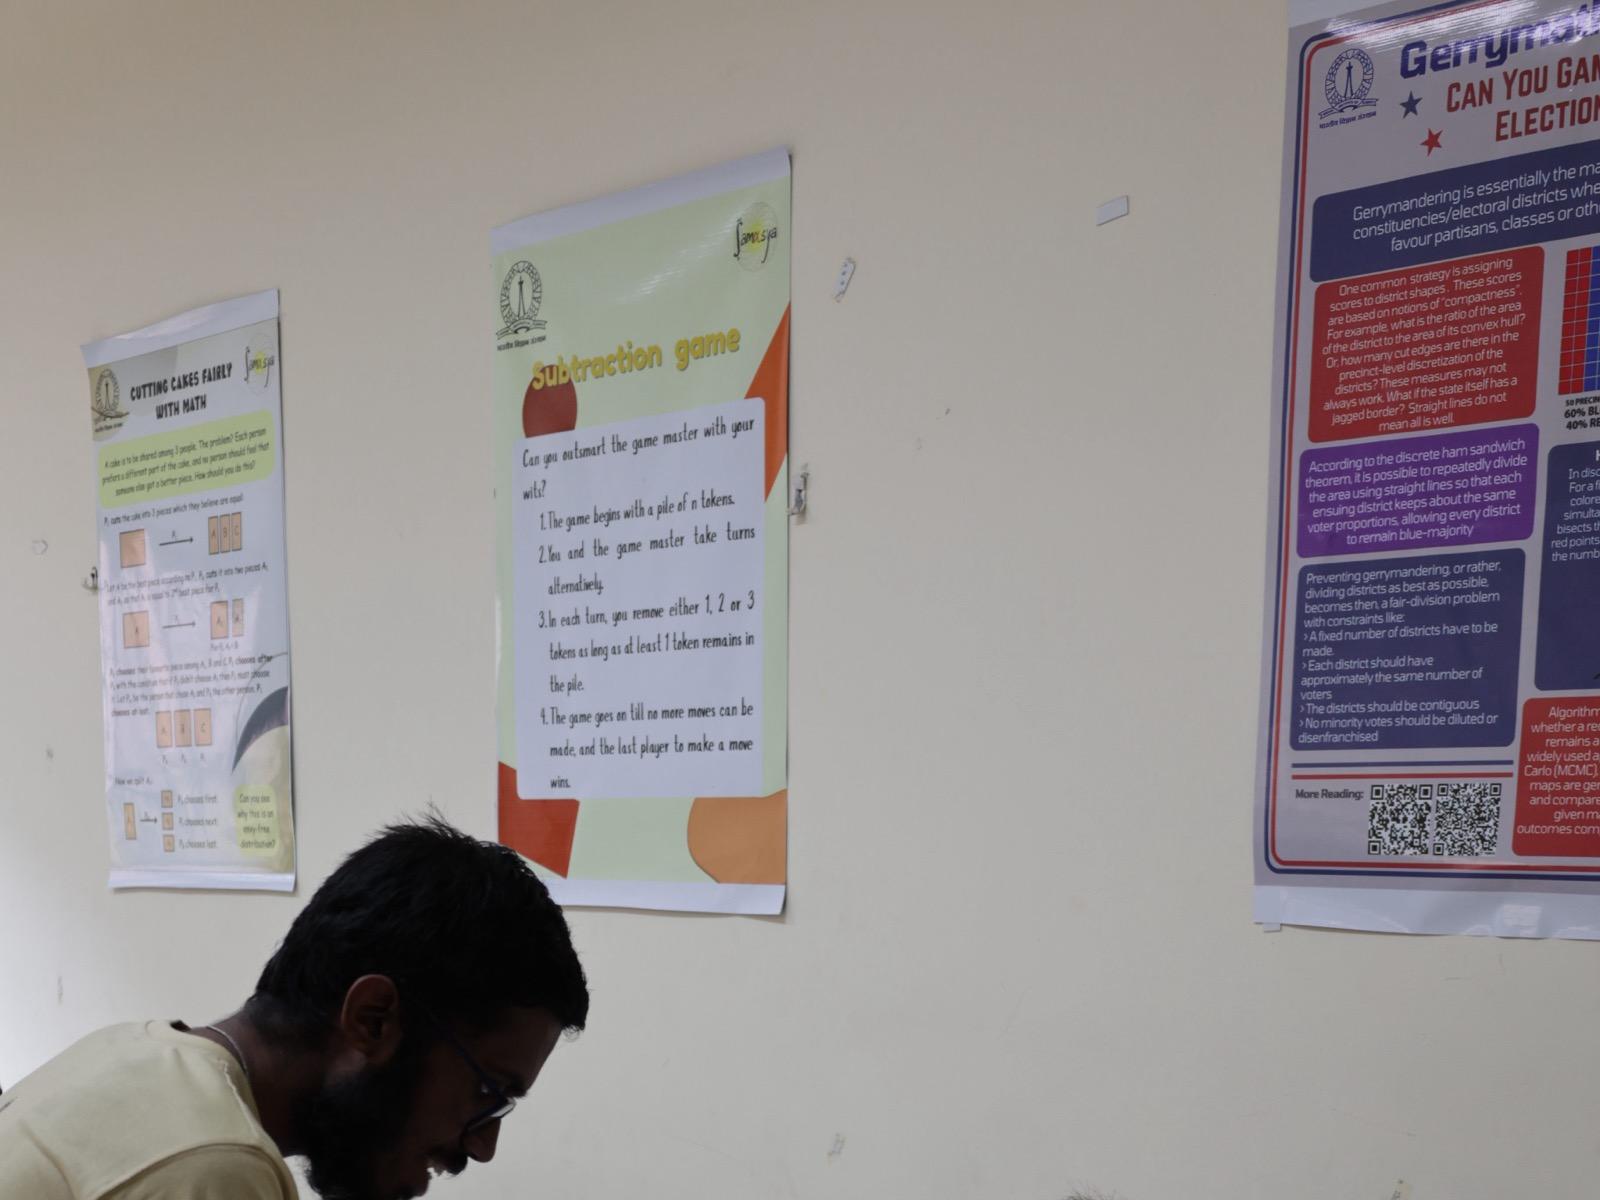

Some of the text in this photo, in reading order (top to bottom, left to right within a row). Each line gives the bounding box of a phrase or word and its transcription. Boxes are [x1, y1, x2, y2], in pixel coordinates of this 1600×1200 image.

[1446, 78, 1494, 112] CAN
[1503, 66, 1548, 100] YOU
[1352, 189, 1460, 220] Gerrymandering
[1476, 169, 1550, 196] essentially
[1552, 166, 1576, 181] the
[1352, 195, 1509, 239] constituencies/electoral
[1511, 188, 1567, 208] districts
[1391, 233, 1432, 251] favour
[1434, 221, 1498, 246] partisans,
[1501, 210, 1554, 230] classes
[1575, 200, 1600, 217] oth
[532, 327, 741, 390] Subtraction game
[130, 362, 233, 401] CUTTING CAKES FAIRLY
[156, 394, 207, 420] WITH MATH
[1564, 406, 1600, 418] 60% BL
[1566, 419, 1588, 430] 40%
[522, 415, 754, 469] Can you outsmart the game master with your
[523, 479, 546, 500] wits?
[548, 510, 563, 528] The
[565, 514, 590, 532] game
[593, 505, 620, 527] begins
[623, 499, 644, 519] with
[656, 495, 674, 520] pile
[676, 491, 688, 511] of
[701, 488, 734, 508] tokens.
[567, 540, 584, 559] and
[592, 538, 608, 556] the
[616, 541, 642, 559] game
[649, 528, 684, 549] master
[694, 524, 716, 544] take
[726, 521, 755, 540] turns
[1552, 552, 1568, 562] the
[560, 607, 580, 626] each
[585, 606, 607, 624] turn,
[612, 610, 627, 627] you
[632, 607, 664, 619] remove
[668, 596, 699, 616] either
[718, 592, 724, 612] 2
[747, 590, 754, 609] 3
[549, 642, 576, 660] tokens
[578, 647, 588, 657] as
[590, 639, 608, 661] long
[610, 644, 621, 655] as
[624, 635, 633, 654] at
[636, 633, 661, 653] least
[672, 631, 699, 650] token
[702, 632, 742, 648] remains
[745, 631, 754, 645] in
[549, 673, 584, 696] the pile.
[550, 706, 566, 724] The
[568, 712, 592, 728] game
[594, 712, 613, 727] goes
[616, 711, 626, 721] on
[630, 702, 644, 720] till
[647, 709, 658, 719] no
[661, 708, 684, 718] more
[687, 706, 715, 717] moves
[719, 705, 737, 716] can
[740, 696, 753, 716] be
[549, 739, 576, 756] made,
[579, 738, 595, 755] and
[599, 737, 614, 754] the
[617, 735, 636, 754] last
[640, 735, 669, 758] player
[674, 734, 683, 752] to
[687, 733, 714, 751] make
[728, 739, 753, 750] move
[550, 776, 570, 788] wins.
[1296, 789, 1364, 800] More Reading:
[1517, 824, 1600, 835] outcomes com
